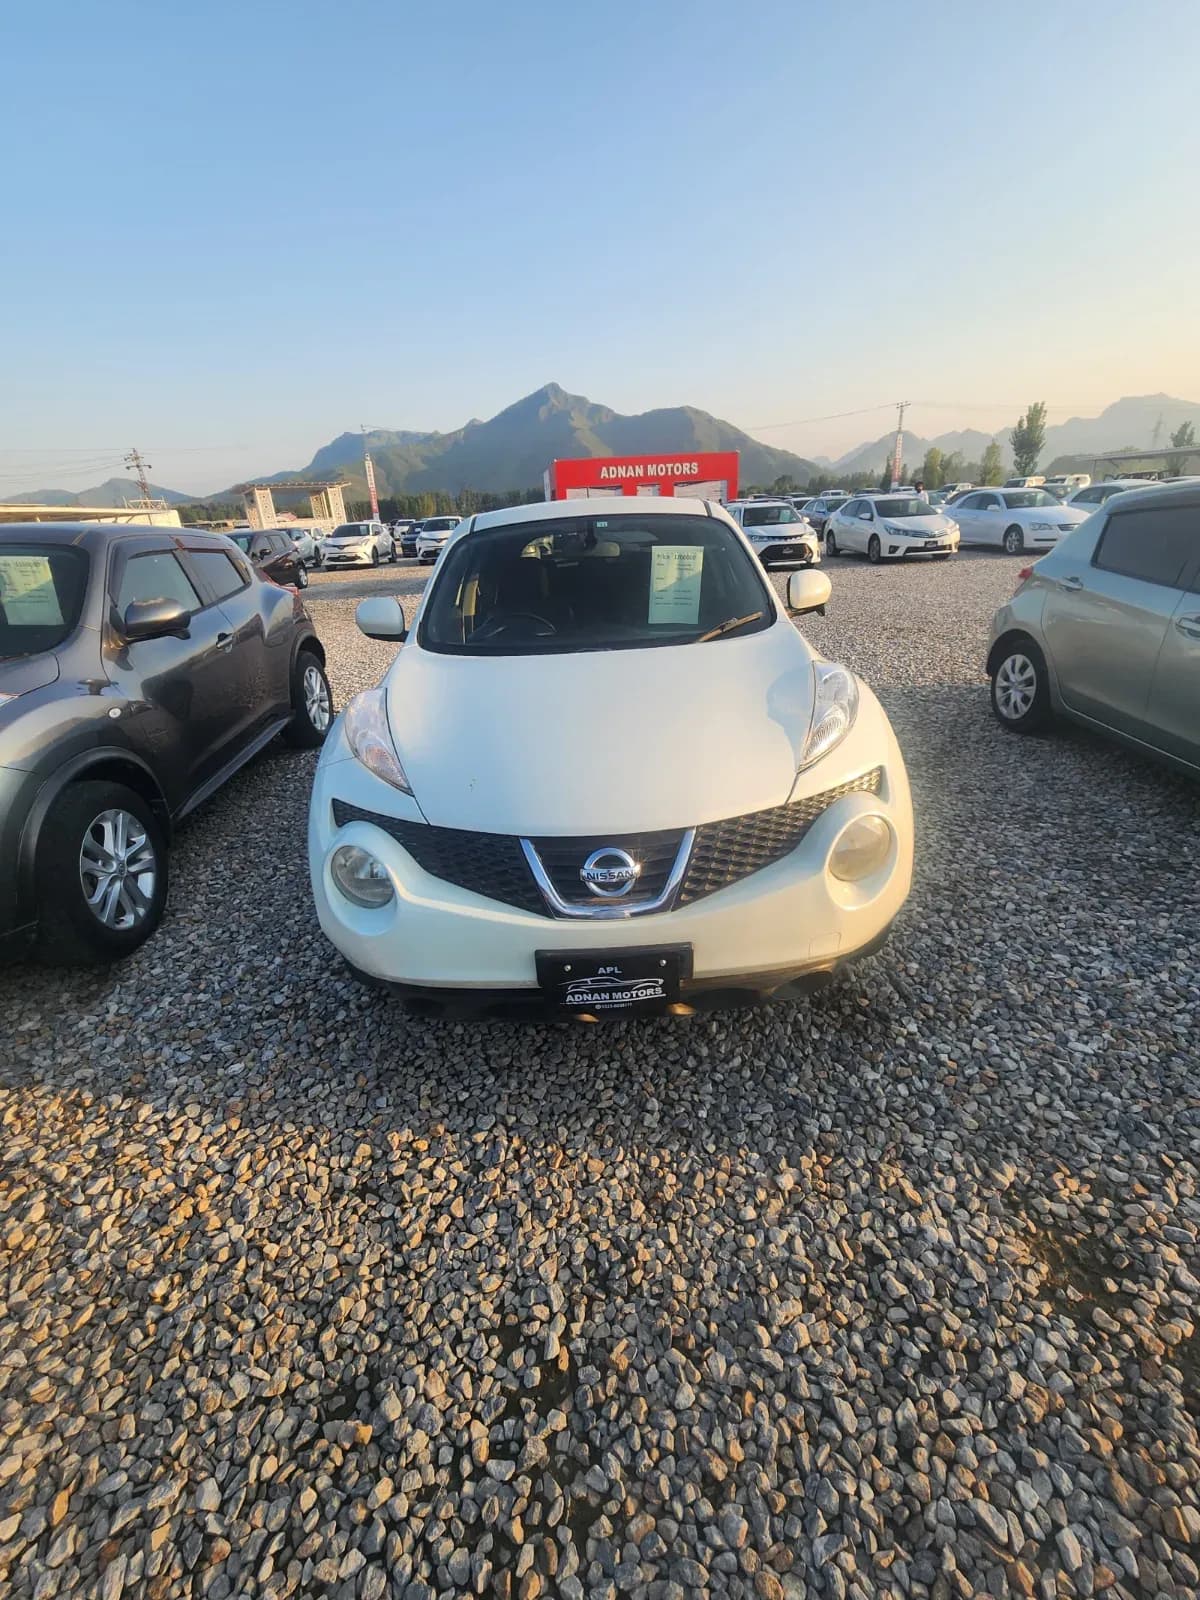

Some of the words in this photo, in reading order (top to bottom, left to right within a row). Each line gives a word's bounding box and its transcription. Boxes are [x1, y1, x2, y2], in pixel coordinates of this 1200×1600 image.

[600, 466, 644, 479] ADNAN
[647, 462, 699, 476] MOTORS
[586, 870, 634, 880] NISSAN
[598, 966, 622, 974] APL
[566, 993, 610, 1002] ADNAN
[612, 987, 663, 1000] MOTORS
